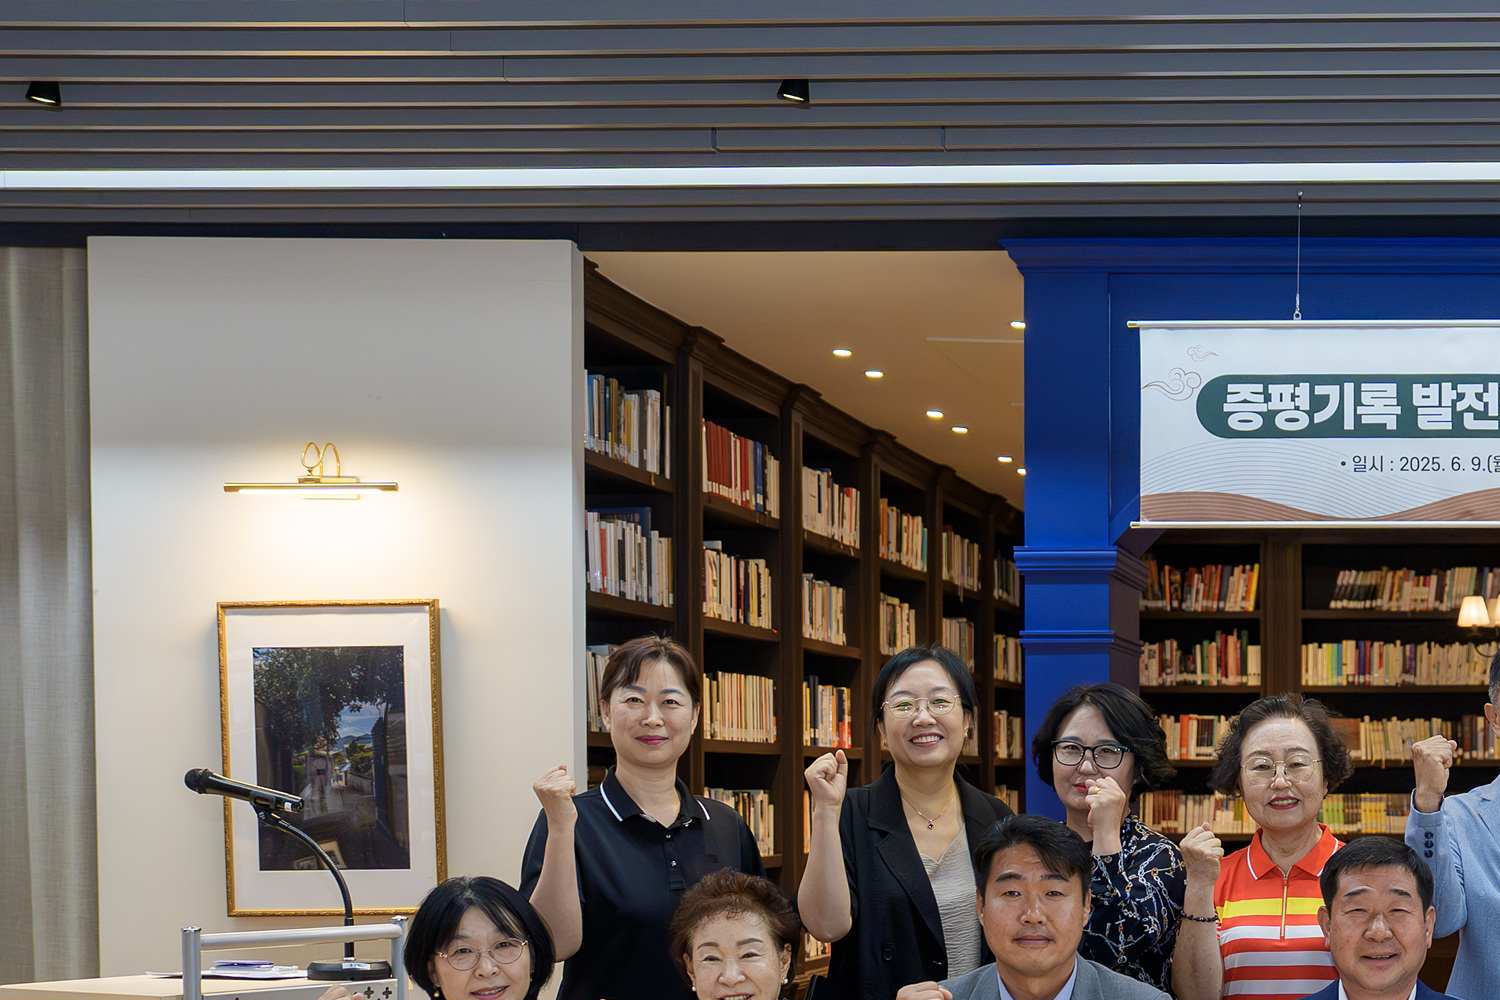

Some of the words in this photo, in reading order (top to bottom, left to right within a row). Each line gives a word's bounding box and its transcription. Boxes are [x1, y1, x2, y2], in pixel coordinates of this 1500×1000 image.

[1222, 381, 1401, 431] 증평기록
[1352, 455, 1384, 473] 일시
[1399, 456, 1445, 472] 2025.
[1451, 456, 1466, 472] 6.
